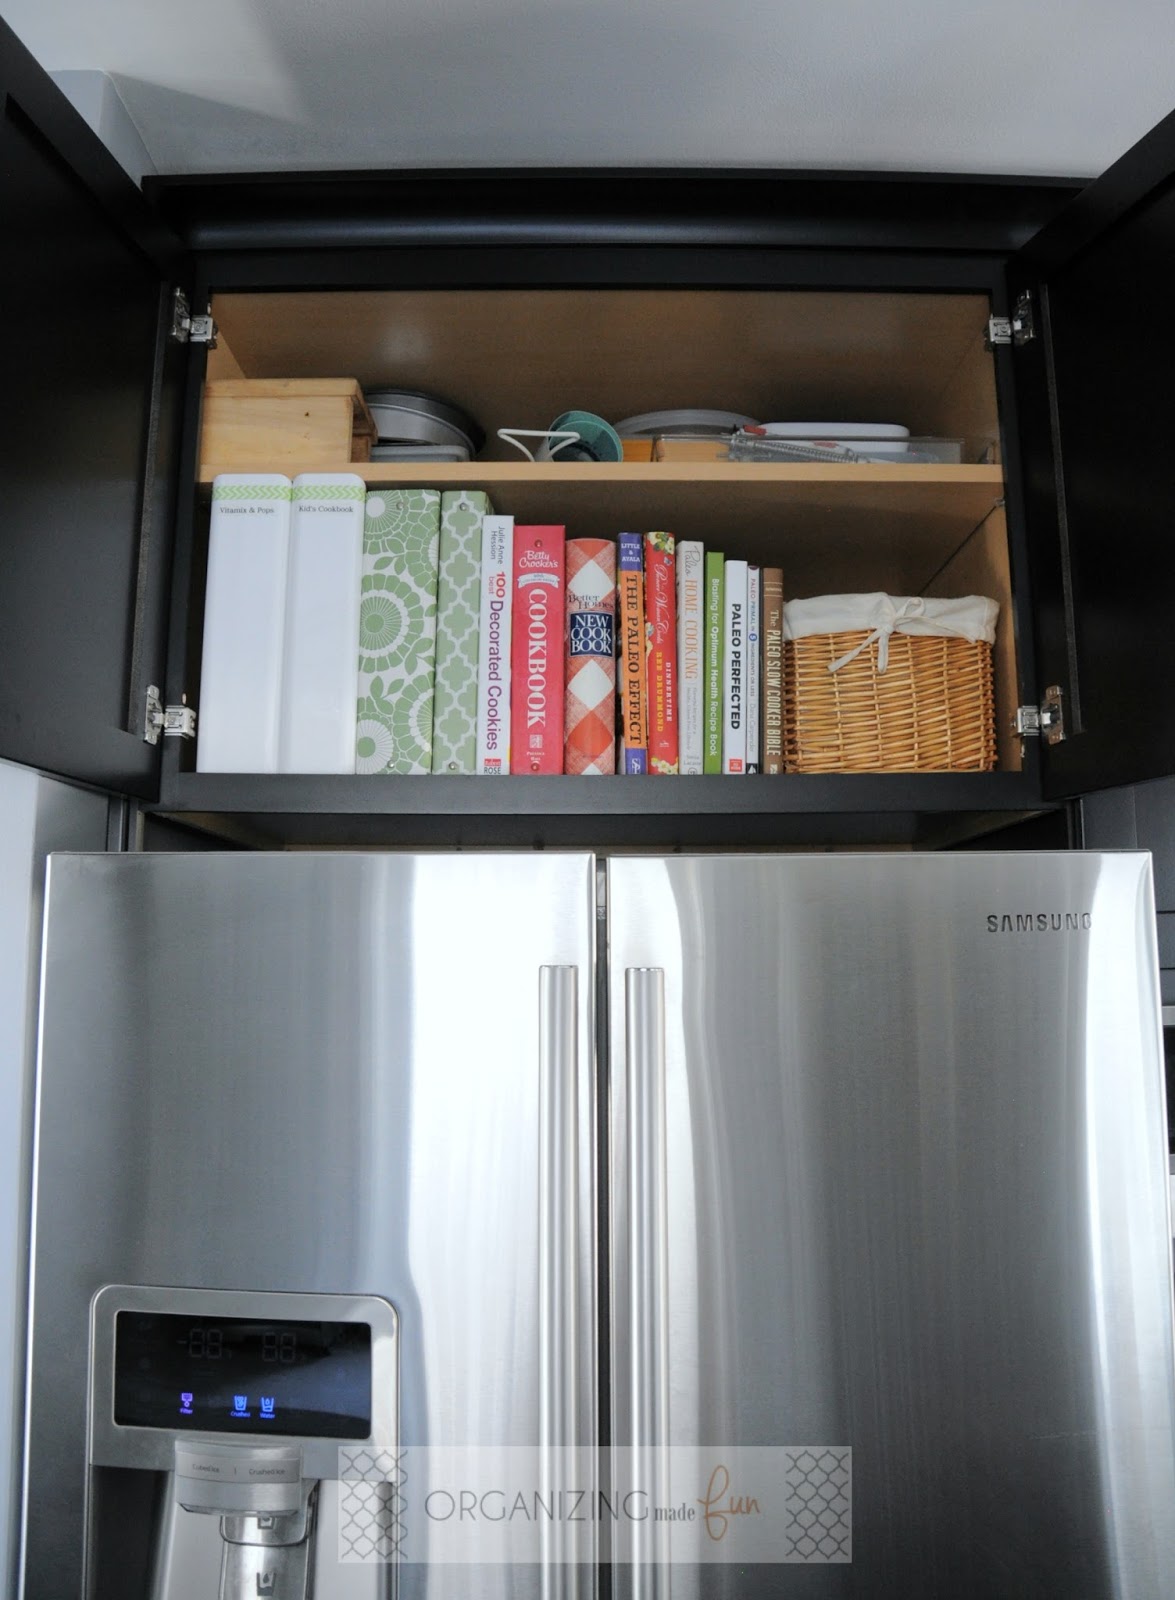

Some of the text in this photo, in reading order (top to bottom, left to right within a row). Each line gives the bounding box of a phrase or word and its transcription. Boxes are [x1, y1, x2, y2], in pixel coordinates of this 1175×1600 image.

[257, 507, 274, 515] Pops
[490, 530, 498, 560] Hession
[498, 526, 506, 543] Julie
[518, 558, 558, 568] Crocker's
[525, 550, 550, 561] Betty
[685, 546, 700, 576] Paleo
[496, 571, 506, 598] 100
[569, 594, 600, 602] Better
[685, 579, 698, 615] HOME
[710, 578, 720, 611] Blasting
[571, 627, 611, 641] COOK
[575, 614, 609, 628] NEW
[528, 588, 548, 728] COOKBOOK
[572, 640, 611, 653] BOOK
[627, 575, 641, 744] THE PALEO EFFECT
[685, 620, 698, 679] COOKING
[710, 626, 719, 667] Optimum
[486, 601, 504, 750] Decorated Cookies
[731, 604, 741, 729] PALEO PERFECTED
[710, 669, 718, 699] Health
[767, 610, 781, 756] The PALEO SLOW COOKER BIBLE
[709, 702, 718, 732] Recipe
[710, 734, 718, 756] Book
[484, 767, 501, 775] ROSE
[986, 912, 1092, 932] SAMSUNG
